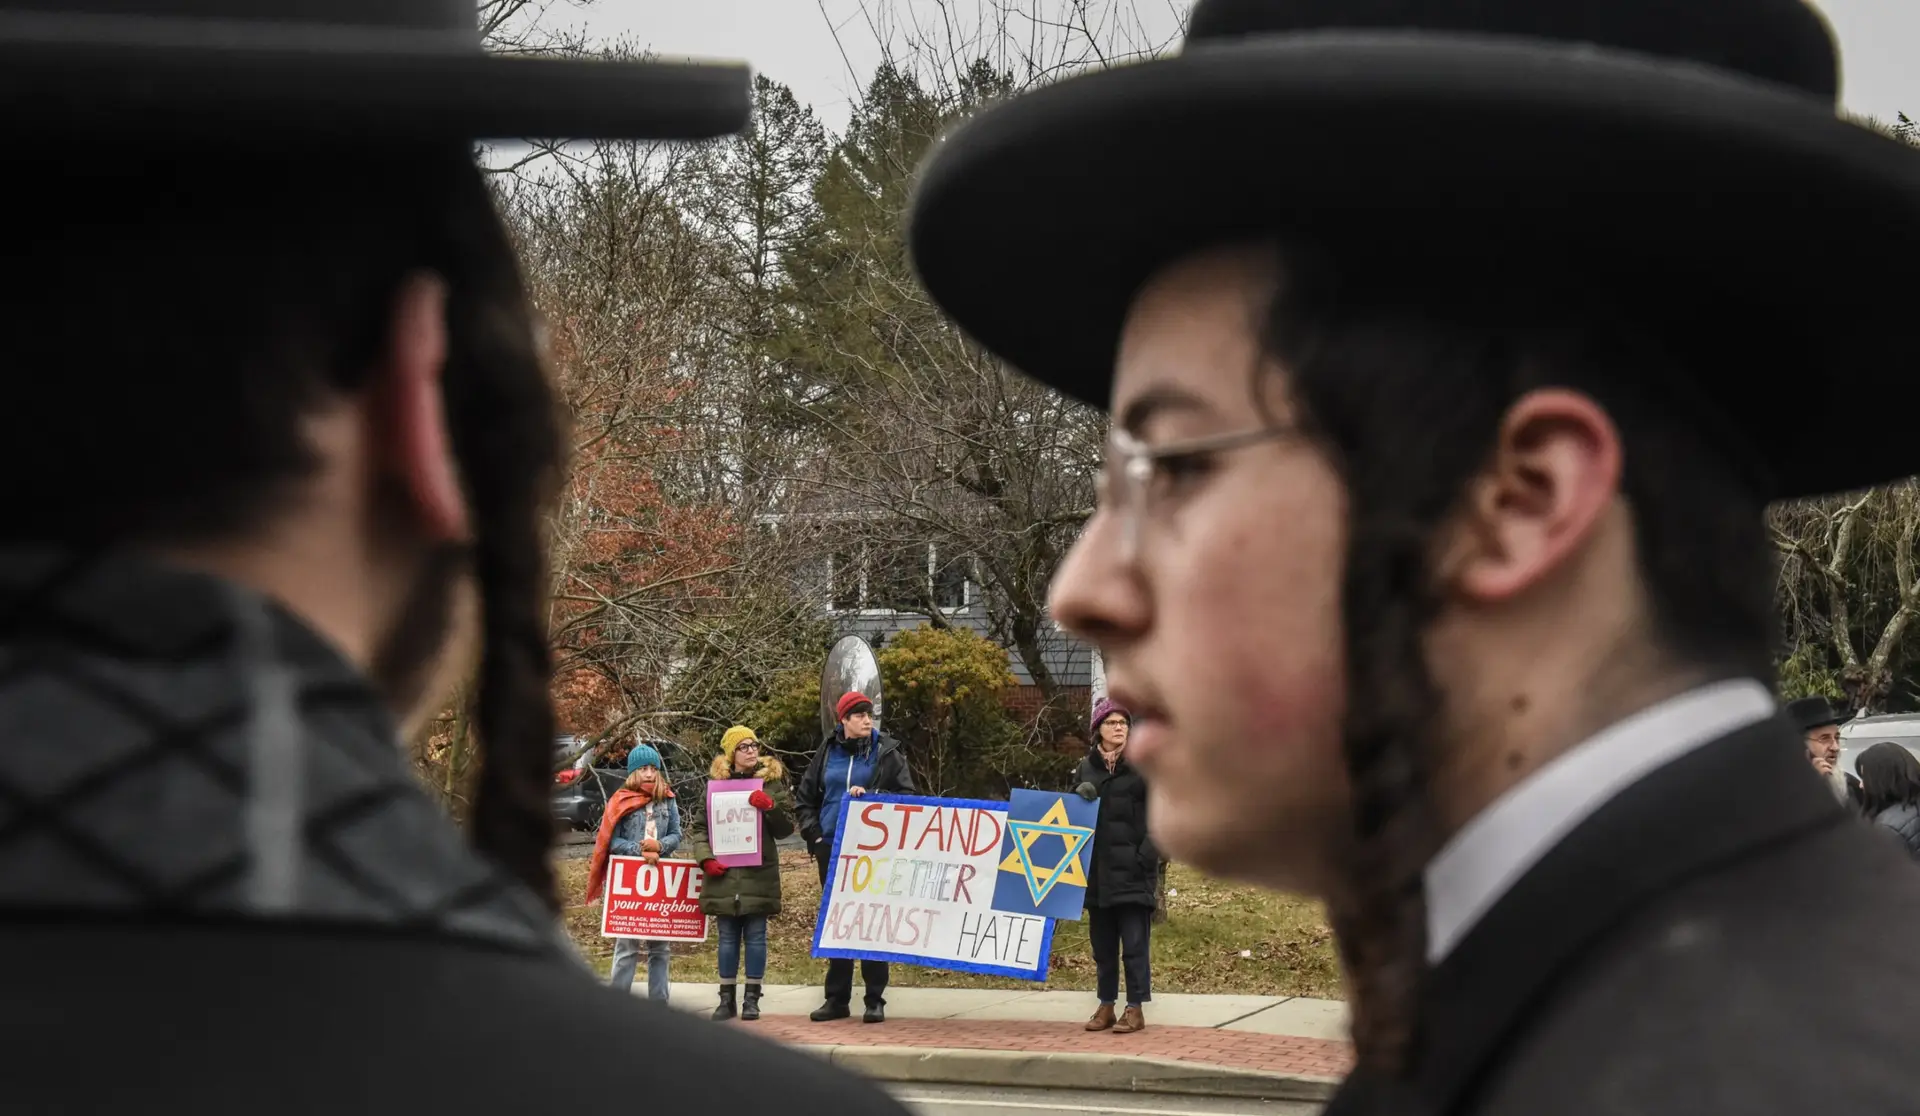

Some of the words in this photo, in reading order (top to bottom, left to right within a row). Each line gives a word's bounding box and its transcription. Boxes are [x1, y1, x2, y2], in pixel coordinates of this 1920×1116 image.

[716, 808, 755, 825] LOVE
[857, 804, 1001, 857] STAND
[612, 862, 704, 899] LOVE
[840, 854, 976, 904] TOGETHER
[610, 900, 642, 913] your
[644, 900, 699, 917] neighbor
[825, 901, 941, 949] AGAINST
[956, 911, 1042, 965] HATE
